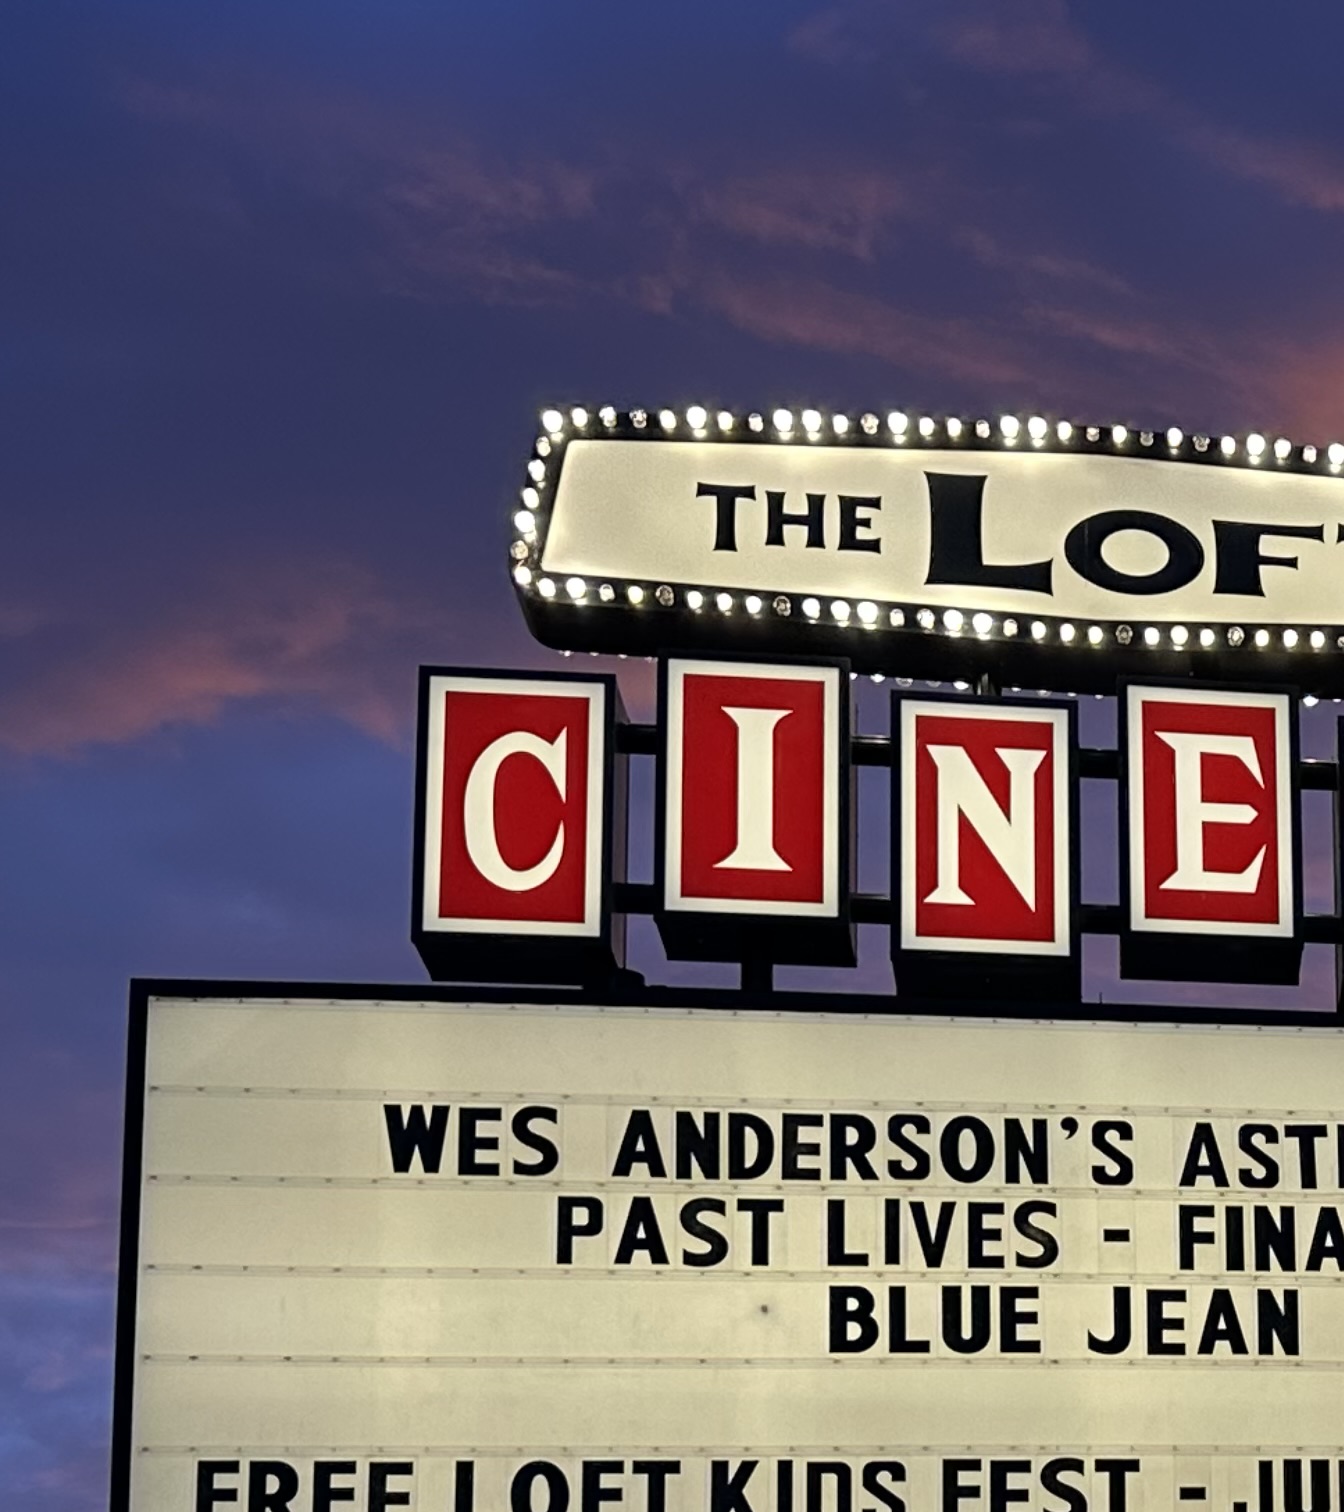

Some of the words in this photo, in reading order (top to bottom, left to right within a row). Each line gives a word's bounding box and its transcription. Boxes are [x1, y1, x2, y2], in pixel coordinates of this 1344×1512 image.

[696, 482, 881, 553] THE
[384, 1105, 558, 1176] WES
[612, 1110, 1133, 1185] ANDERSON'S
[557, 1196, 784, 1267] PAST
[828, 1199, 1058, 1268] LIVES
[829, 1286, 1040, 1353] BLUE
[1088, 1287, 1299, 1355] JEAN
